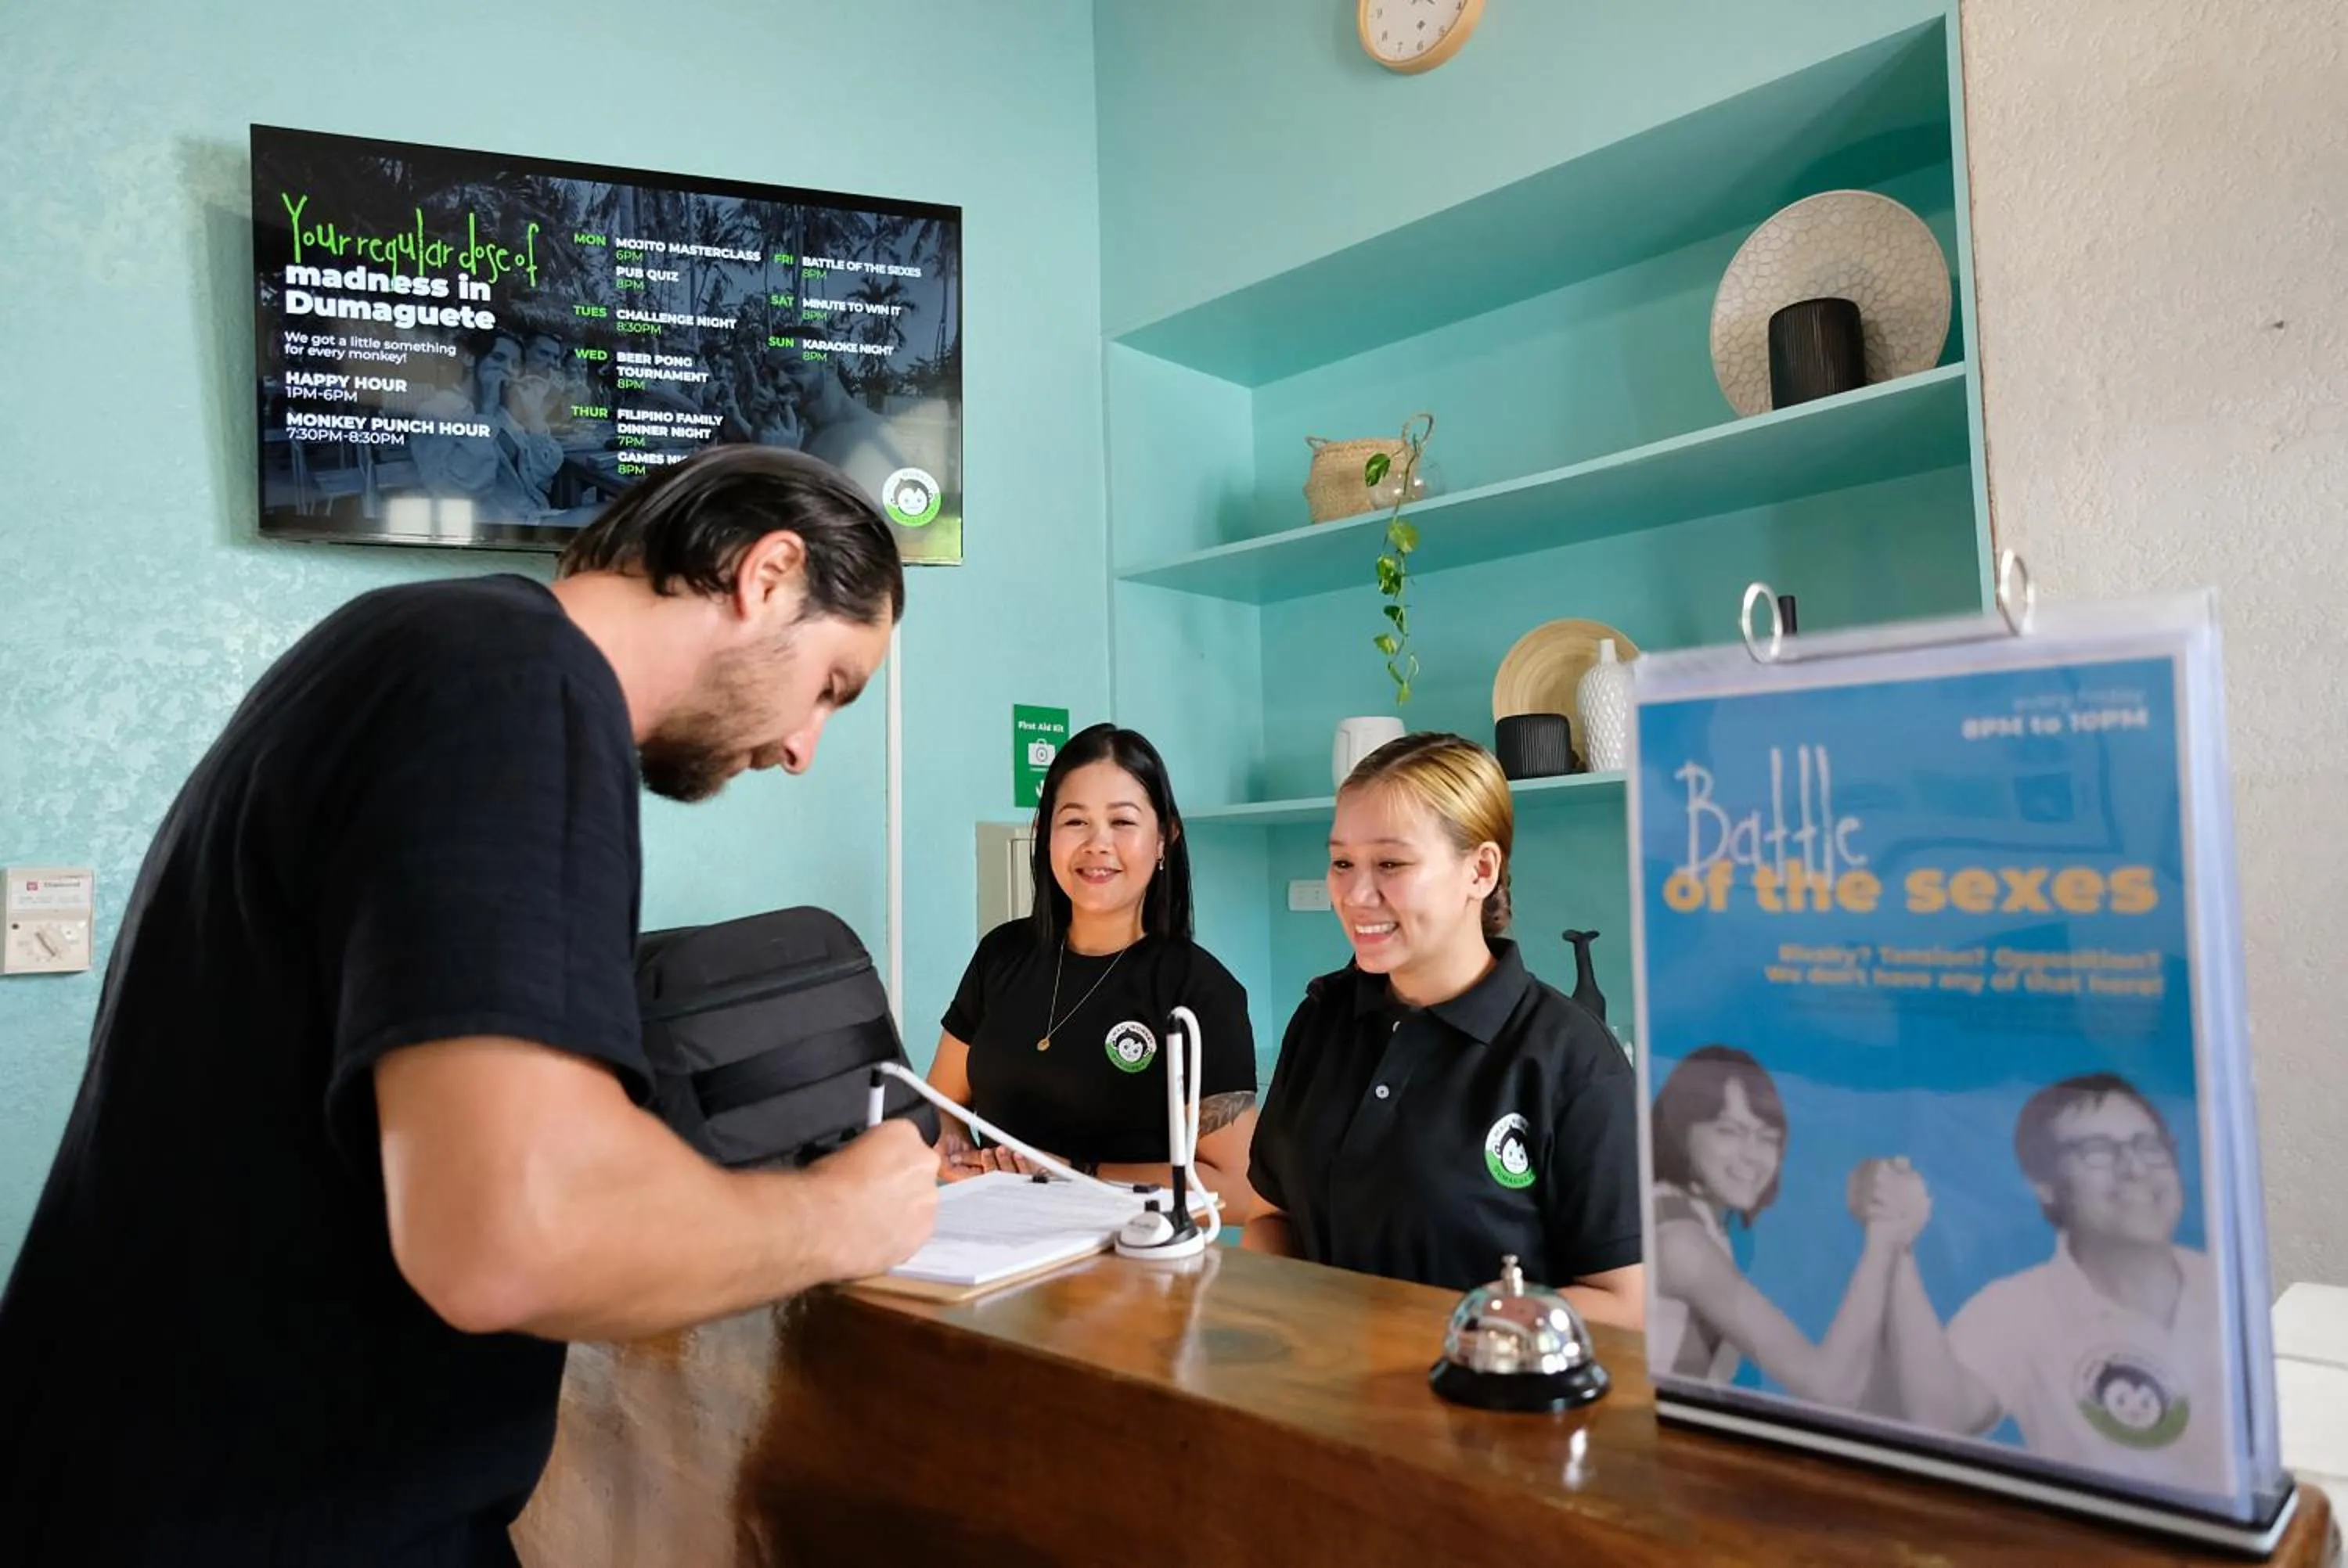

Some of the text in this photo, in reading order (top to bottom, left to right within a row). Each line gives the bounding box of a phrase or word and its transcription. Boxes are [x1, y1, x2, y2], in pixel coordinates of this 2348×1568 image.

[1416, 41, 1424, 52] 6
[283, 193, 540, 287] Your regular dose of
[574, 234, 607, 246] MON
[616, 238, 762, 261] MOJITO MASTERCLASS
[616, 250, 643, 261] 6PM
[774, 254, 794, 265] FRI
[803, 257, 922, 278] BATTLE OF THE SEXES
[616, 266, 679, 282] PUB QUIZ
[285, 264, 491, 301] madness in
[616, 279, 644, 290] 8PM
[771, 295, 794, 307] SAT
[803, 298, 902, 316] MINUTE TO WIN IT
[285, 290, 496, 329] Dumaguete
[573, 305, 607, 318] TUES
[616, 310, 738, 329] CHALLENGE NIGHT
[616, 322, 661, 335] 8:30PM
[285, 332, 456, 357] We got a little something
[769, 336, 794, 348] SUN
[803, 340, 894, 355] KARAOKE NIGHT
[285, 343, 407, 365] for every monkey!
[574, 348, 607, 361] WED
[617, 352, 693, 368] BEER PONG
[286, 371, 407, 393] HAPPY HOUR
[617, 366, 709, 383] TOURNAMENT
[618, 378, 646, 390] 8PM
[286, 387, 358, 402] 1PM-6PM
[571, 405, 608, 419] THUR
[617, 408, 724, 426] FILIPINO FAMILY
[286, 412, 491, 438] MONKEY PUNCH HOUR
[618, 423, 712, 440] DINNER NIGHT
[286, 428, 405, 445] 7:30PM-8:30PM
[618, 436, 646, 448] 7PM
[618, 451, 664, 466] GAMES
[618, 465, 646, 476] 8PM
[1018, 721, 1064, 733] First Aid Kit
[2029, 715, 2062, 734] to
[1674, 744, 1868, 889] Battle
[1663, 858, 2159, 914] of the sexes
